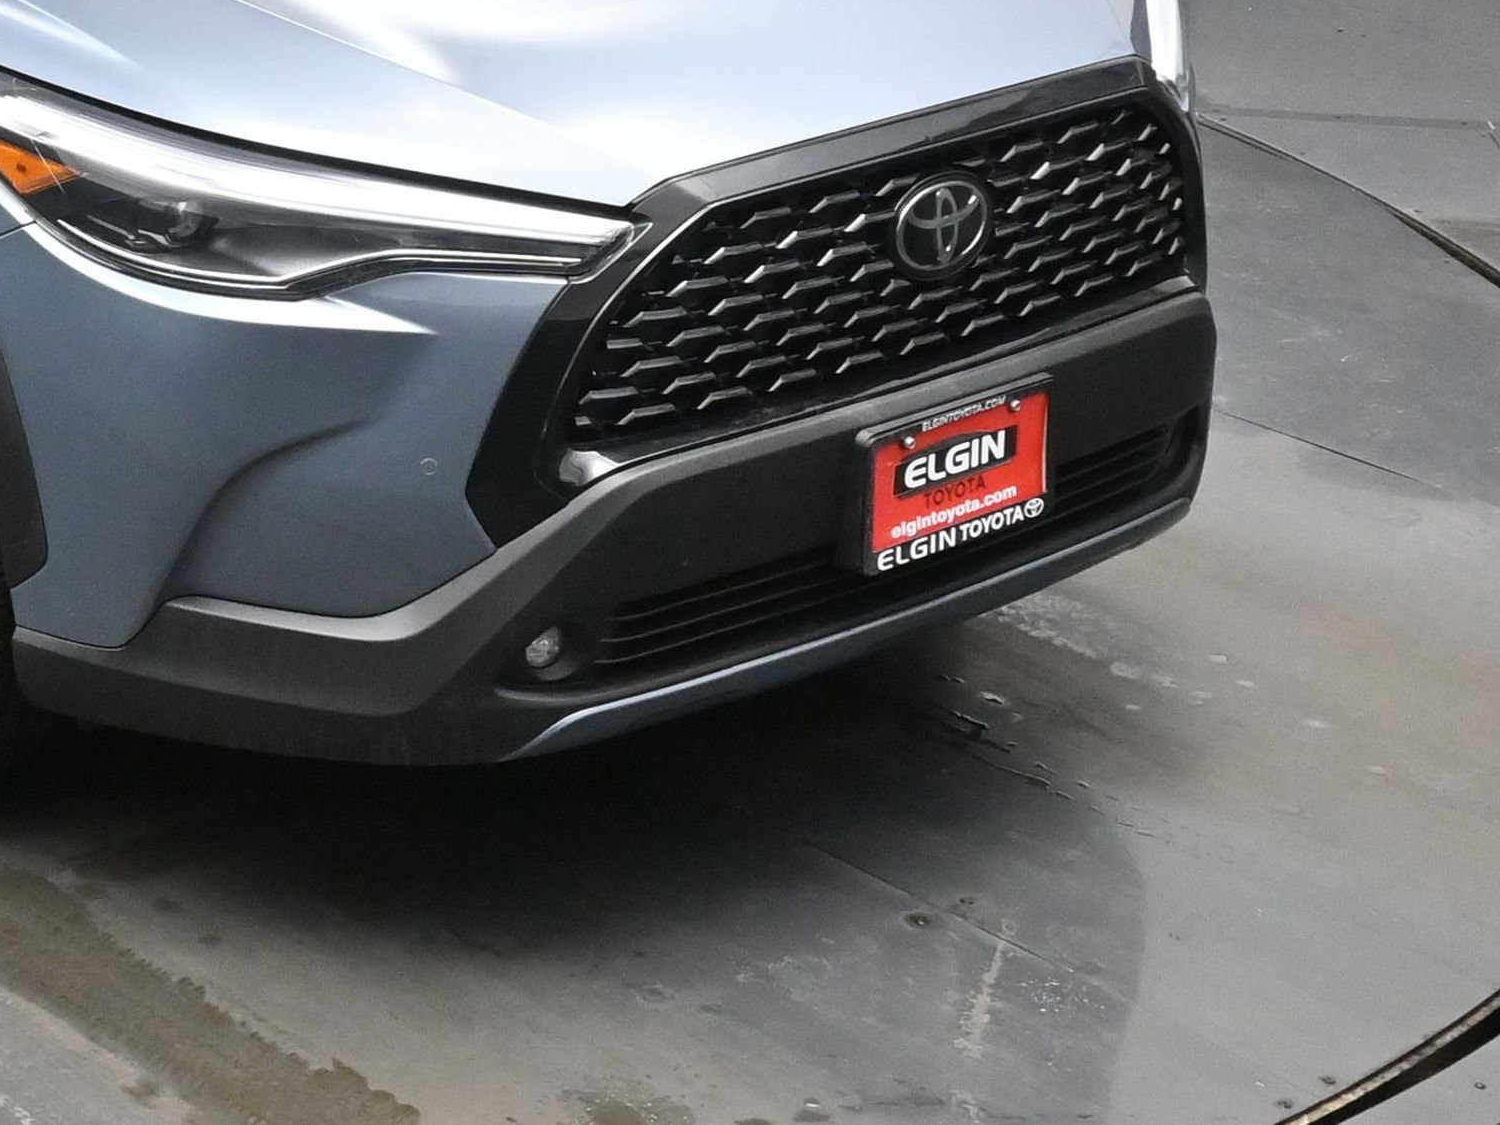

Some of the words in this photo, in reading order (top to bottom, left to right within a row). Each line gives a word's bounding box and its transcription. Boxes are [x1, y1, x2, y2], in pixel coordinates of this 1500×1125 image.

[921, 395, 1007, 432] ELGINTOYOTA.COM
[904, 429, 1006, 489] ELGIN
[891, 485, 1017, 539] elgintoyota.com
[924, 475, 987, 509] TOYOTA
[877, 527, 956, 572] ELGIN
[959, 505, 1025, 542] TOYOTA
